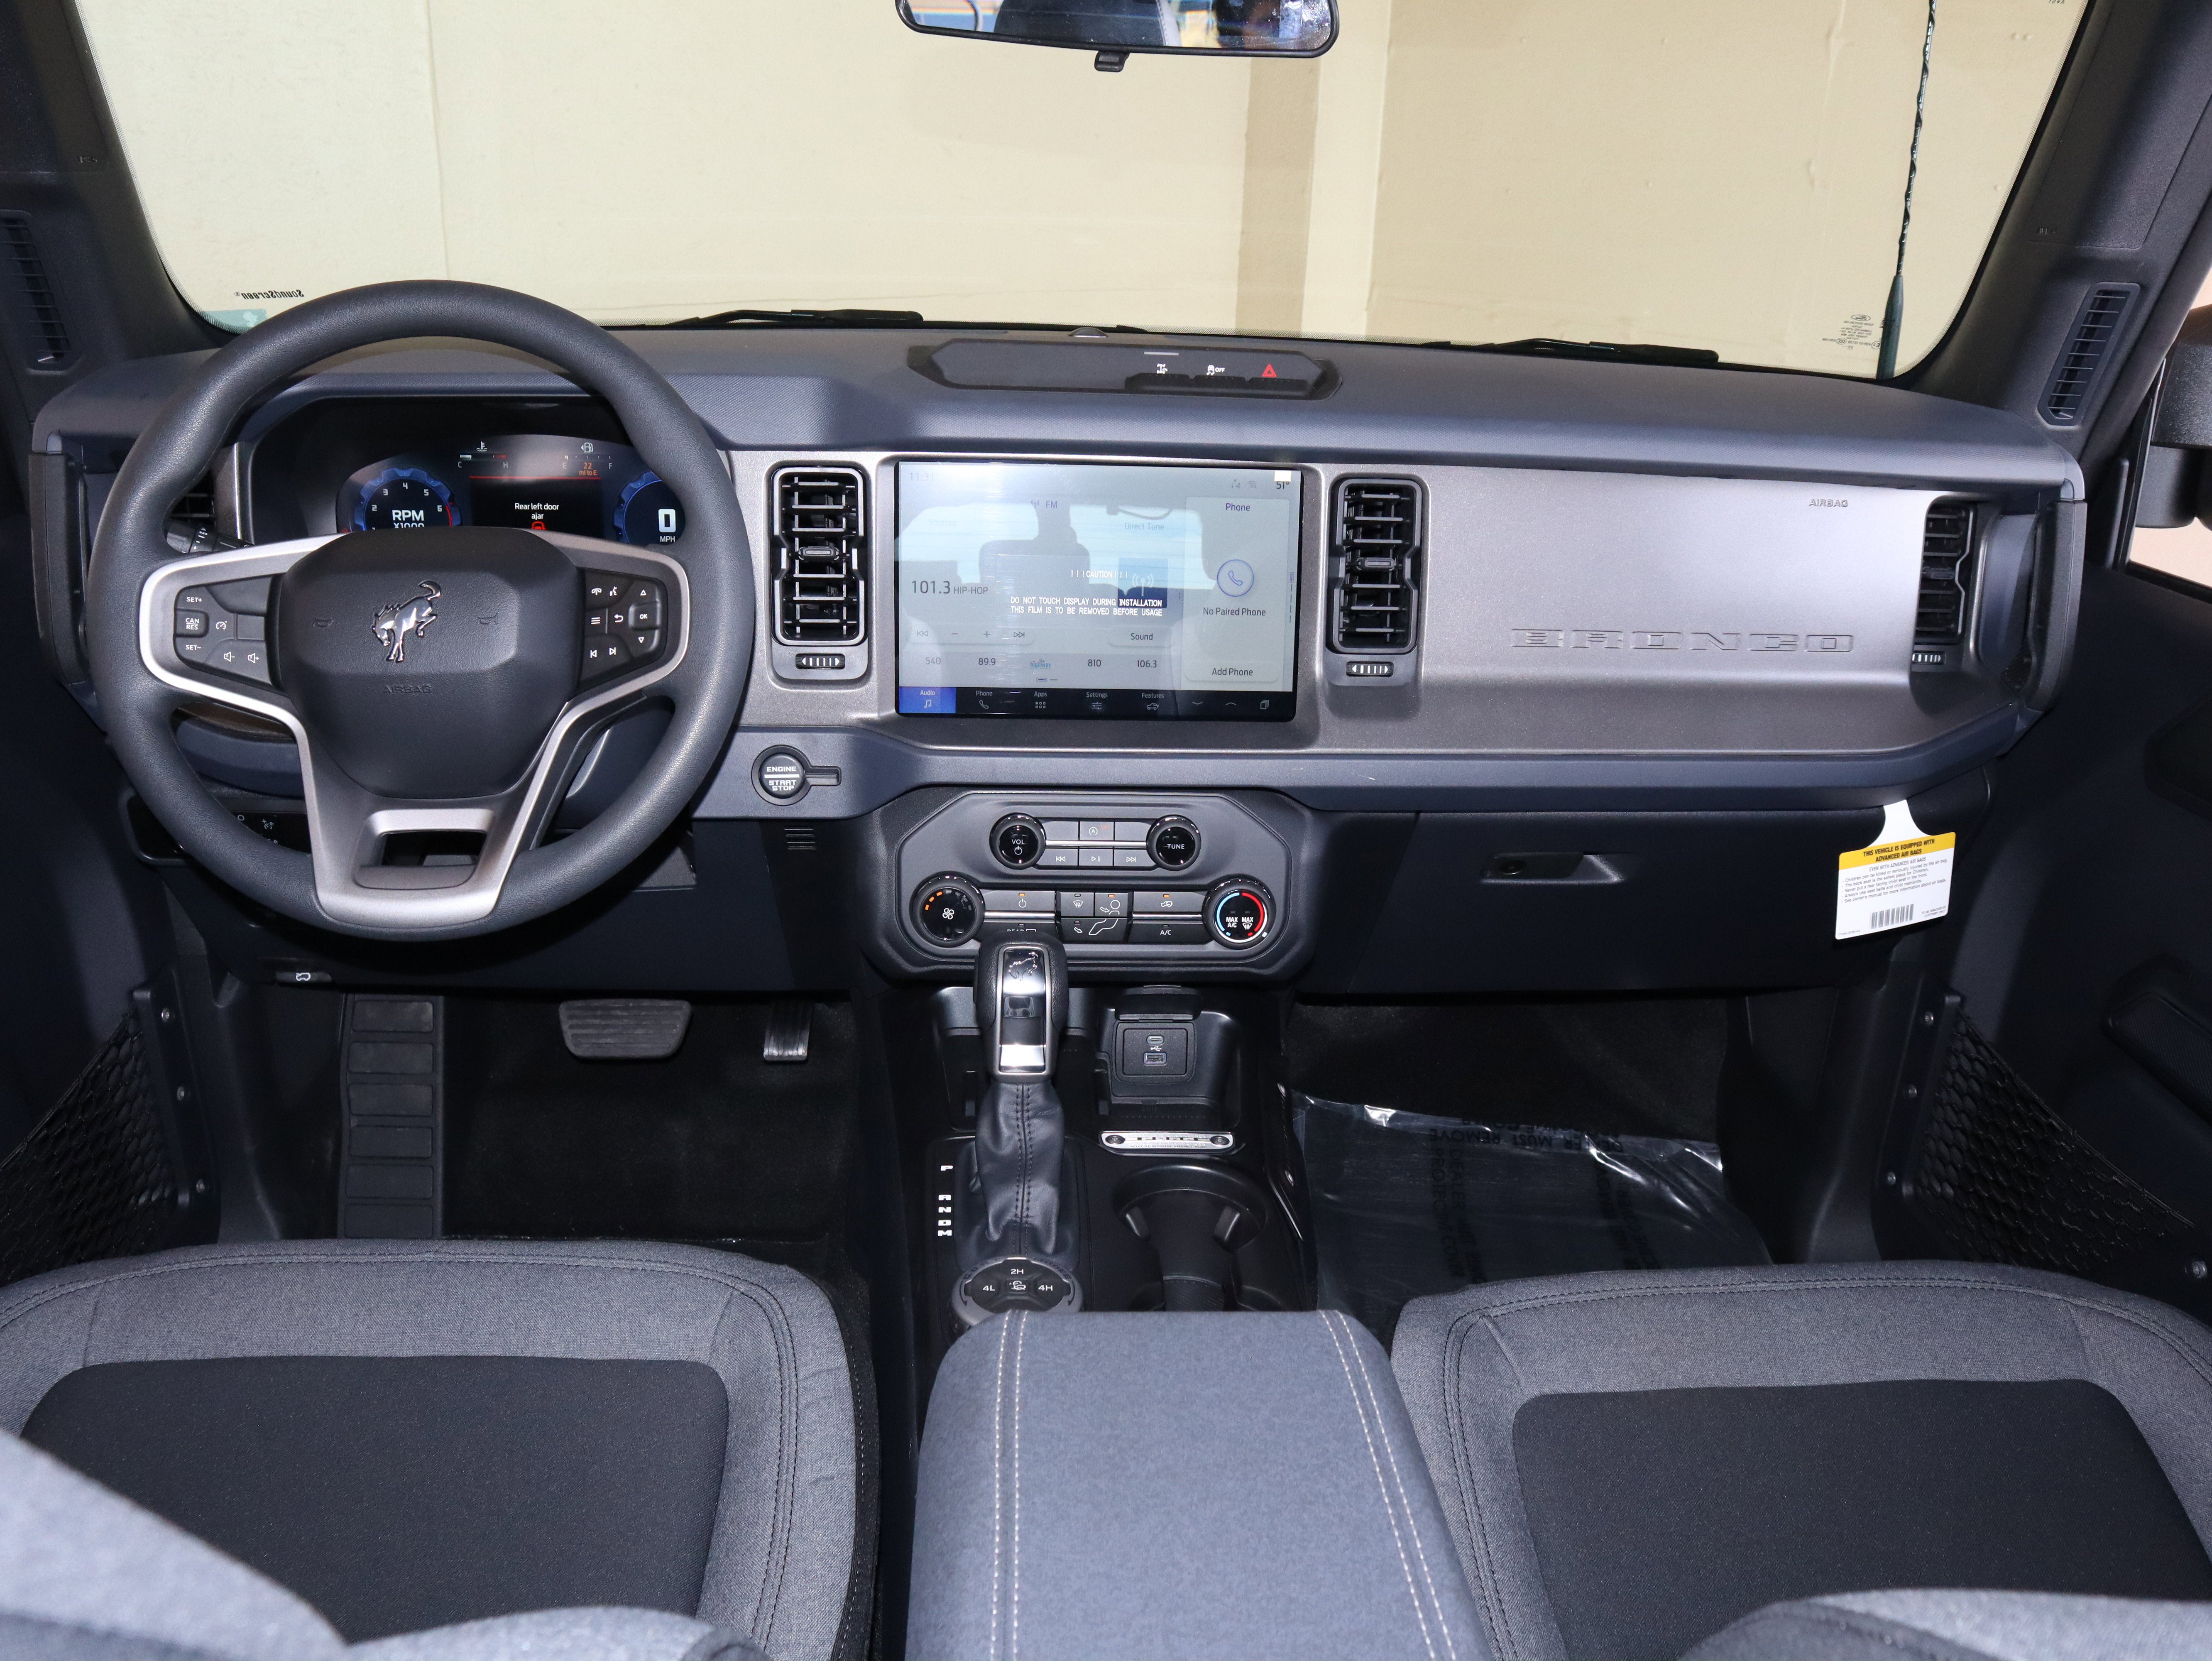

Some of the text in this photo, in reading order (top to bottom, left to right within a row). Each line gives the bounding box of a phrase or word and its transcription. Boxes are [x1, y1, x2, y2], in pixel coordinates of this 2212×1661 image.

[1046, 500, 1058, 509] FM
[1226, 503, 1250, 512] Phone
[1808, 498, 1849, 508] AIRBAG
[392, 510, 425, 521] RPM
[658, 508, 676, 533] 0
[911, 580, 989, 595] 101.3 HIP-HOP
[1064, 598, 1090, 606] DISPLAY
[1093, 598, 1116, 606] DURING
[1119, 599, 1162, 607] INSTALLATION
[1079, 607, 1110, 615] REMOVED
[1203, 607, 1266, 617] No Paired Phone
[1130, 633, 1153, 641] Sound
[1510, 628, 1854, 652] BRONCO
[925, 657, 942, 665] 540
[978, 657, 996, 666] 89.9
[1030, 661, 1052, 669] highway
[1087, 659, 1102, 667] 810
[1211, 667, 1253, 676] Add Phone
[383, 685, 433, 694] AIRBAG
[1875, 846, 1893, 855] VEHICLE
[1901, 840, 1922, 850] EQUIPPED
[1876, 852, 1899, 862] ADVANCED
[1429, 1128, 1501, 1145] REMOVE
